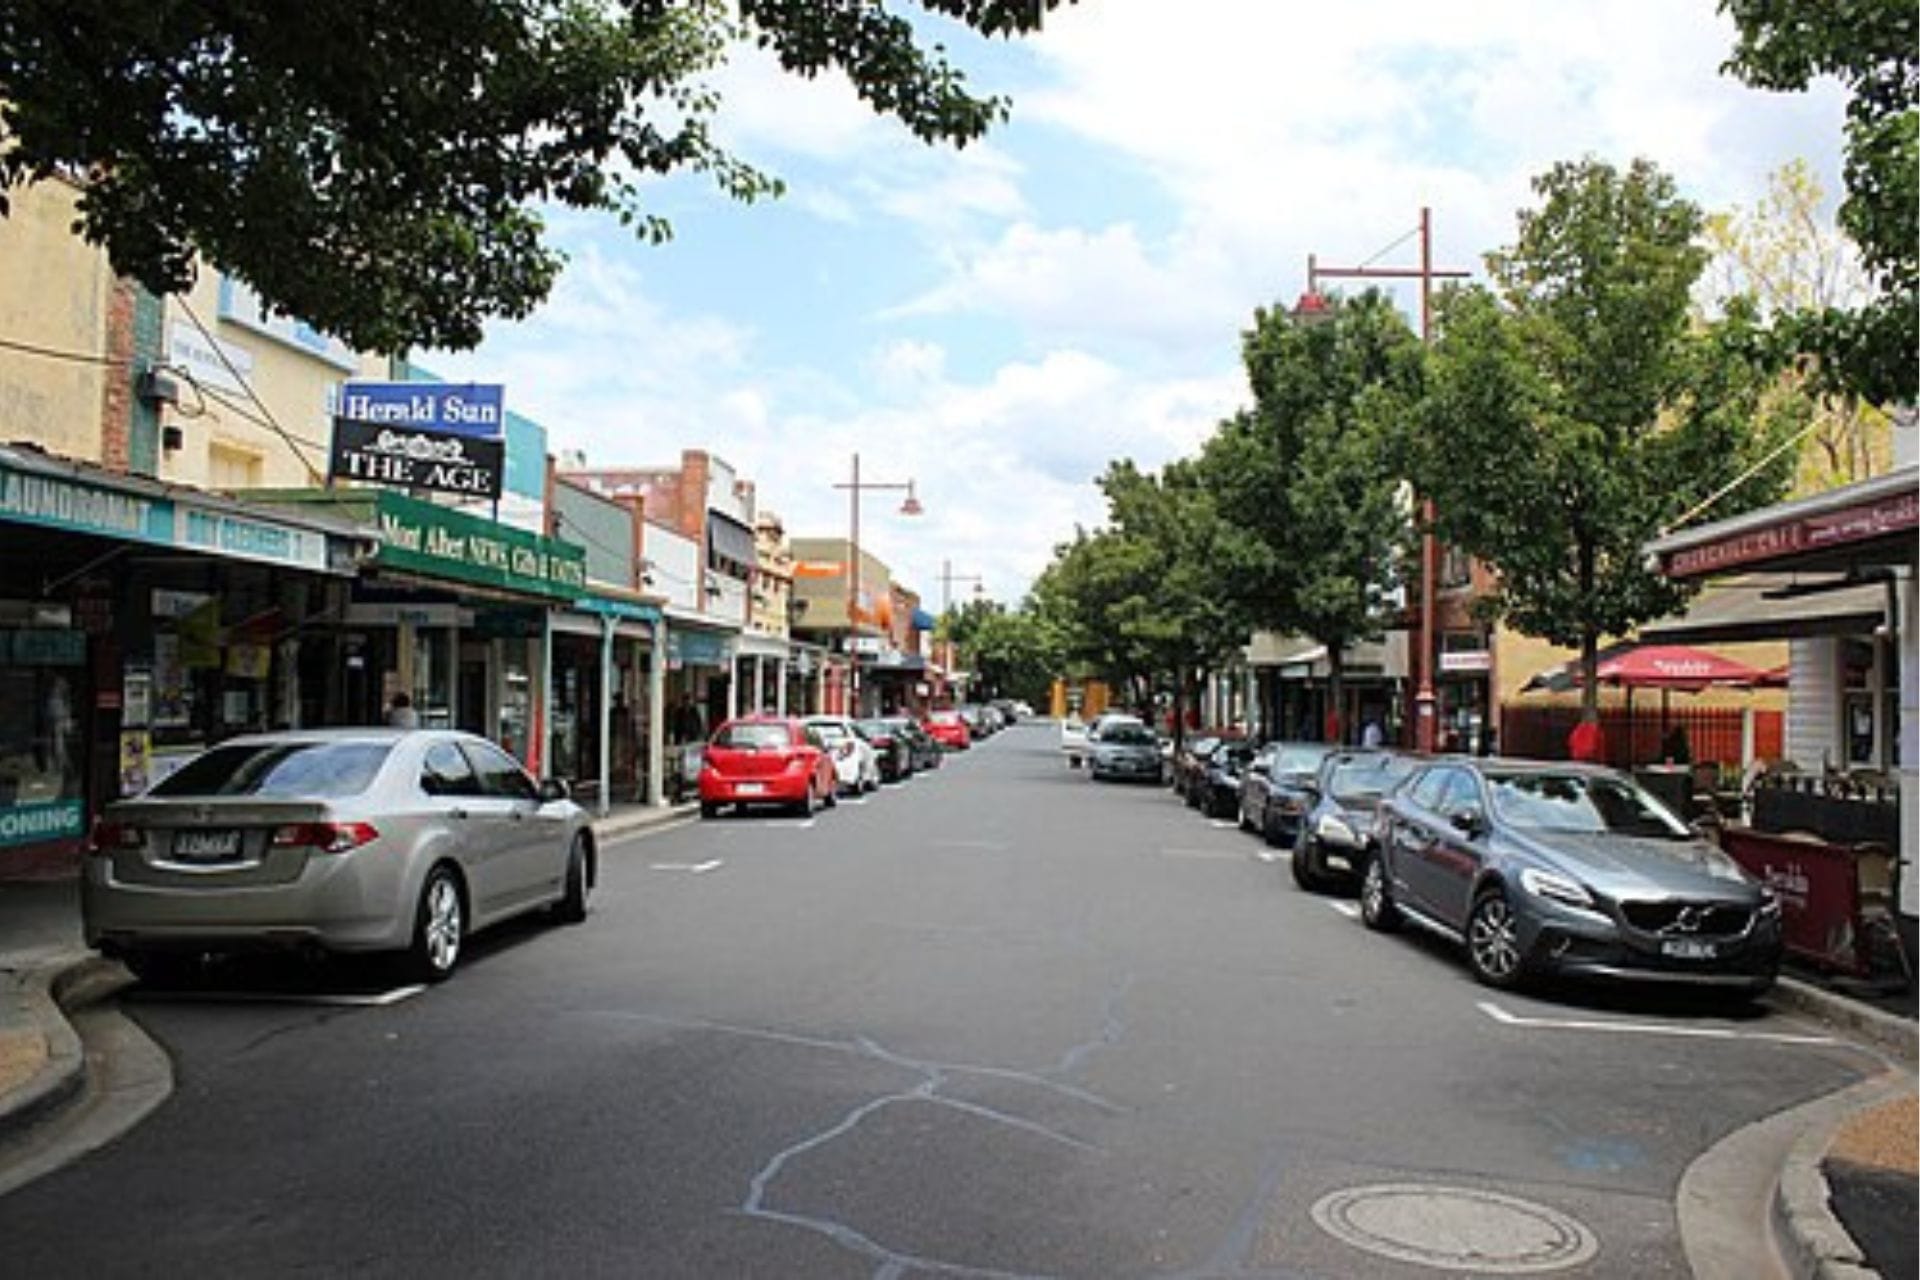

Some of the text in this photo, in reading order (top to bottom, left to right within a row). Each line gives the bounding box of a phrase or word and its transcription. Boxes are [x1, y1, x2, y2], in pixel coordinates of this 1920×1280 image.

[347, 395, 497, 423] Herald Sun
[342, 452, 492, 492] THE AGE
[0, 473, 151, 536] AUNDROMAT
